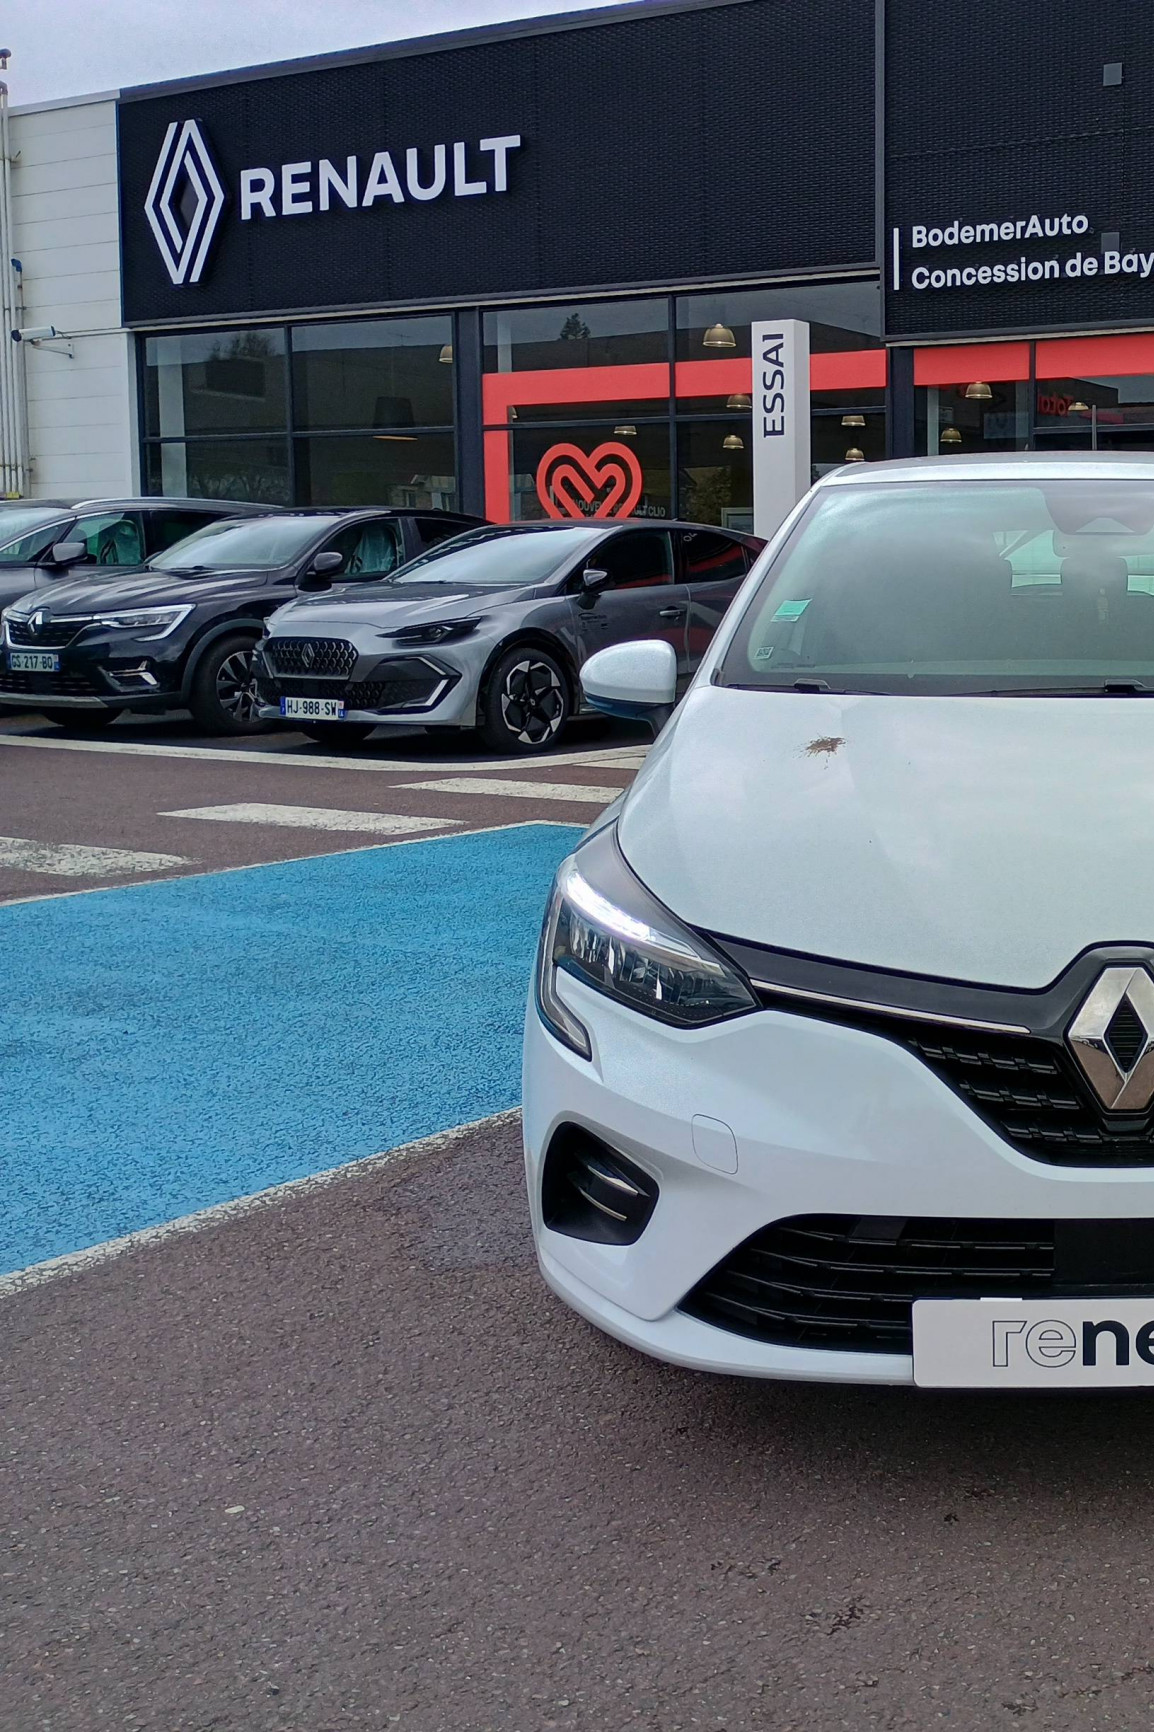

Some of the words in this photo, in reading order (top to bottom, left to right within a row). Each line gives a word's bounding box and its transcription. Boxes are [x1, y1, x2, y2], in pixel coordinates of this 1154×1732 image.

[240, 135, 521, 221] RENAULT
[911, 213, 1089, 248] BodemerAuto
[911, 257, 1060, 290] Concession
[1065, 252, 1098, 277] de
[762, 333, 785, 438] ESSAI
[286, 699, 337, 716] HJ-988-SW
